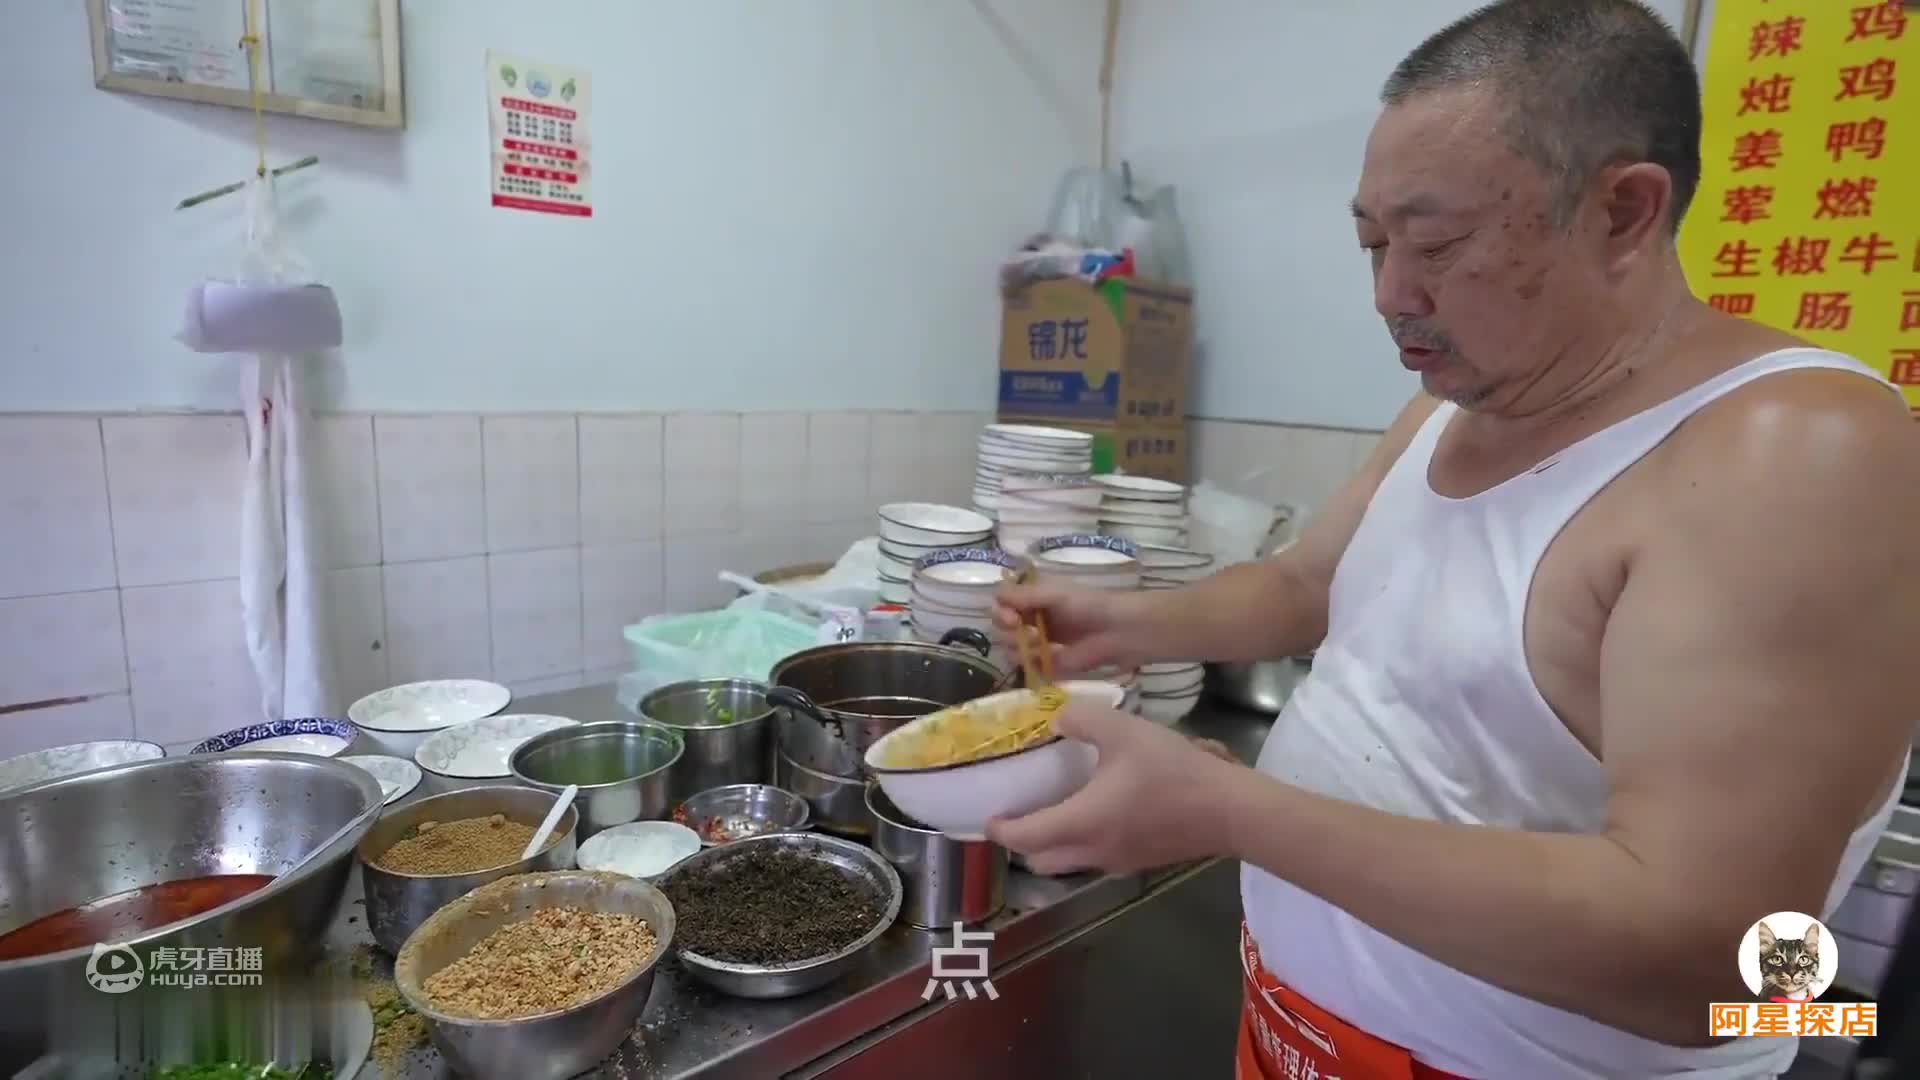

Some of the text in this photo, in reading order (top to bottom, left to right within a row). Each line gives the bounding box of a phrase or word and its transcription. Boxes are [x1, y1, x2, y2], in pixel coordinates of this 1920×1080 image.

[1711, 232, 1920, 279] 生椒牛
[1028, 318, 1089, 361] 锦龙
